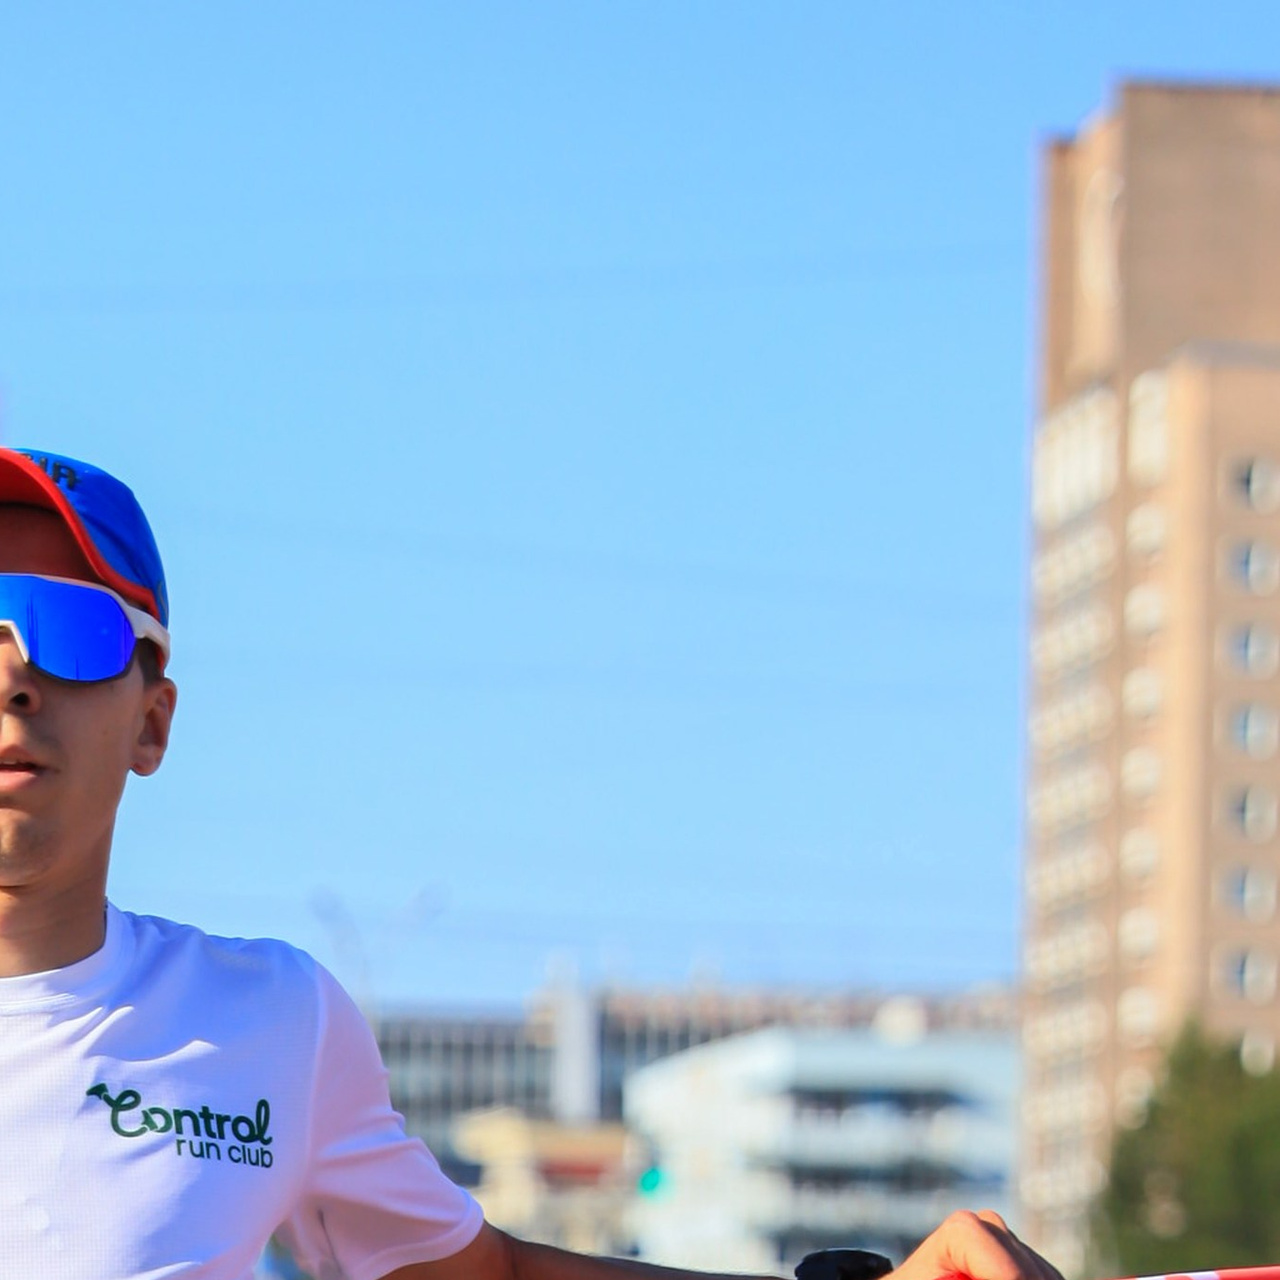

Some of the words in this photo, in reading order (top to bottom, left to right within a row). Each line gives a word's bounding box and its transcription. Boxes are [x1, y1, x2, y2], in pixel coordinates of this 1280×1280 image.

[87, 1083, 272, 1146] Control
[176, 1138, 221, 1160] run
[228, 1144, 273, 1168] club
